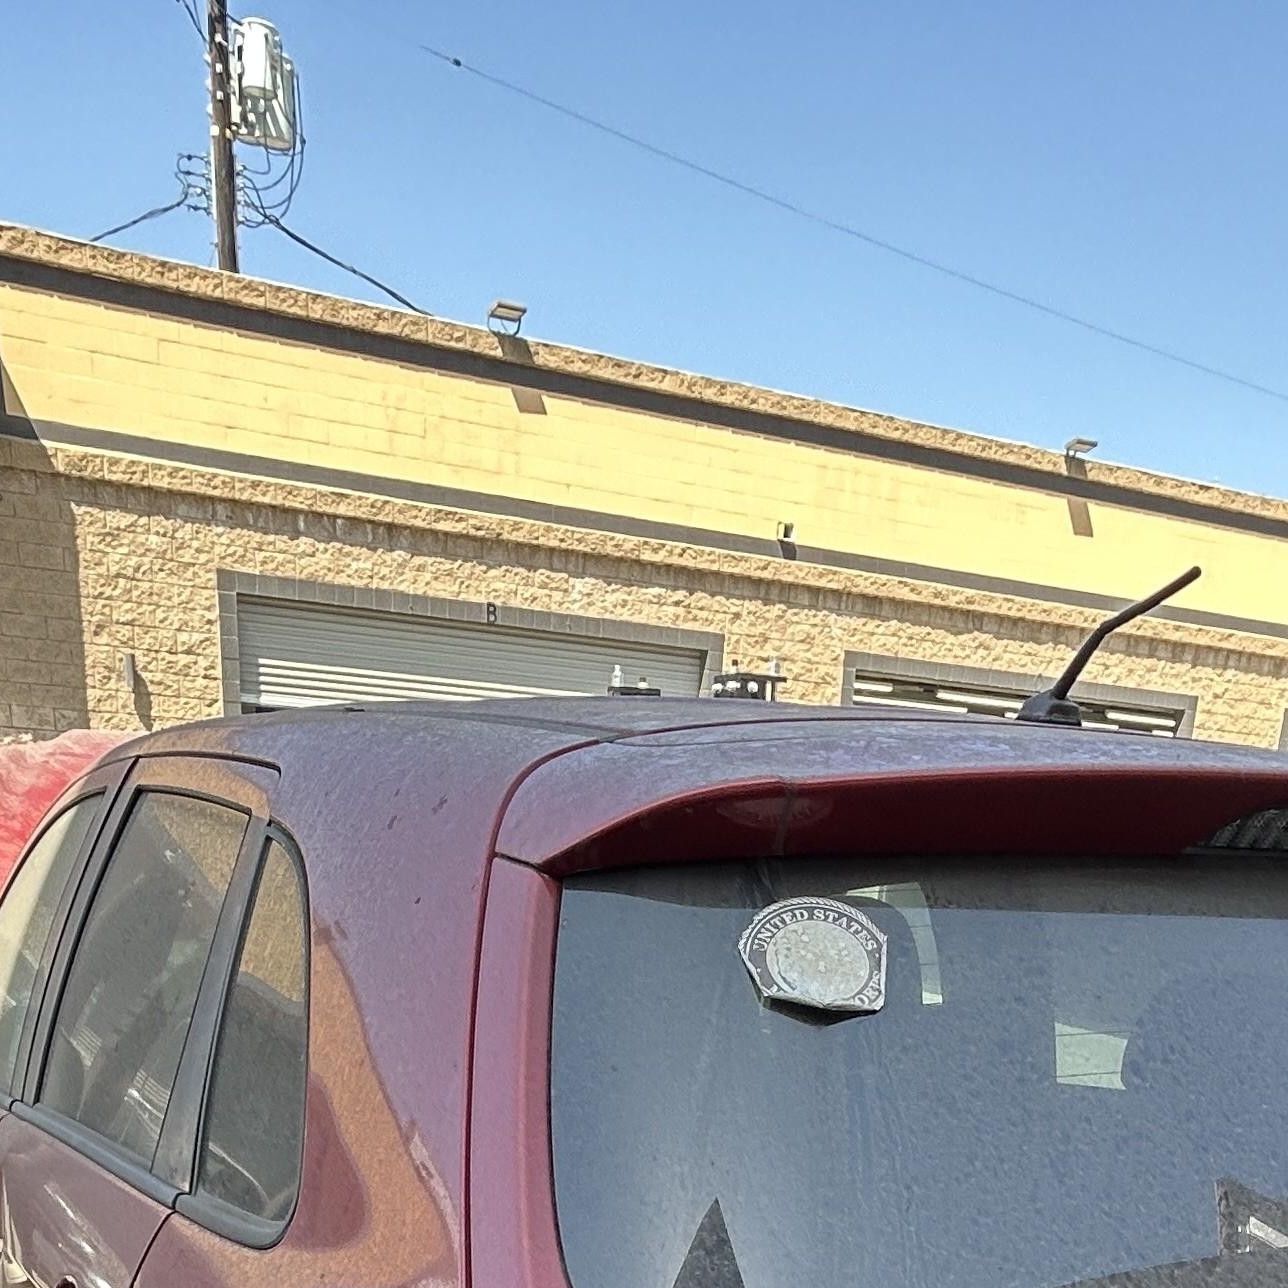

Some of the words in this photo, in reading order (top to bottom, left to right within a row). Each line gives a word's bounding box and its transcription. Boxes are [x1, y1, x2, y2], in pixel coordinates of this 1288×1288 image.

[486, 601, 498, 624] B
[753, 909, 809, 952] UNITED
[813, 909, 878, 951] STATES
